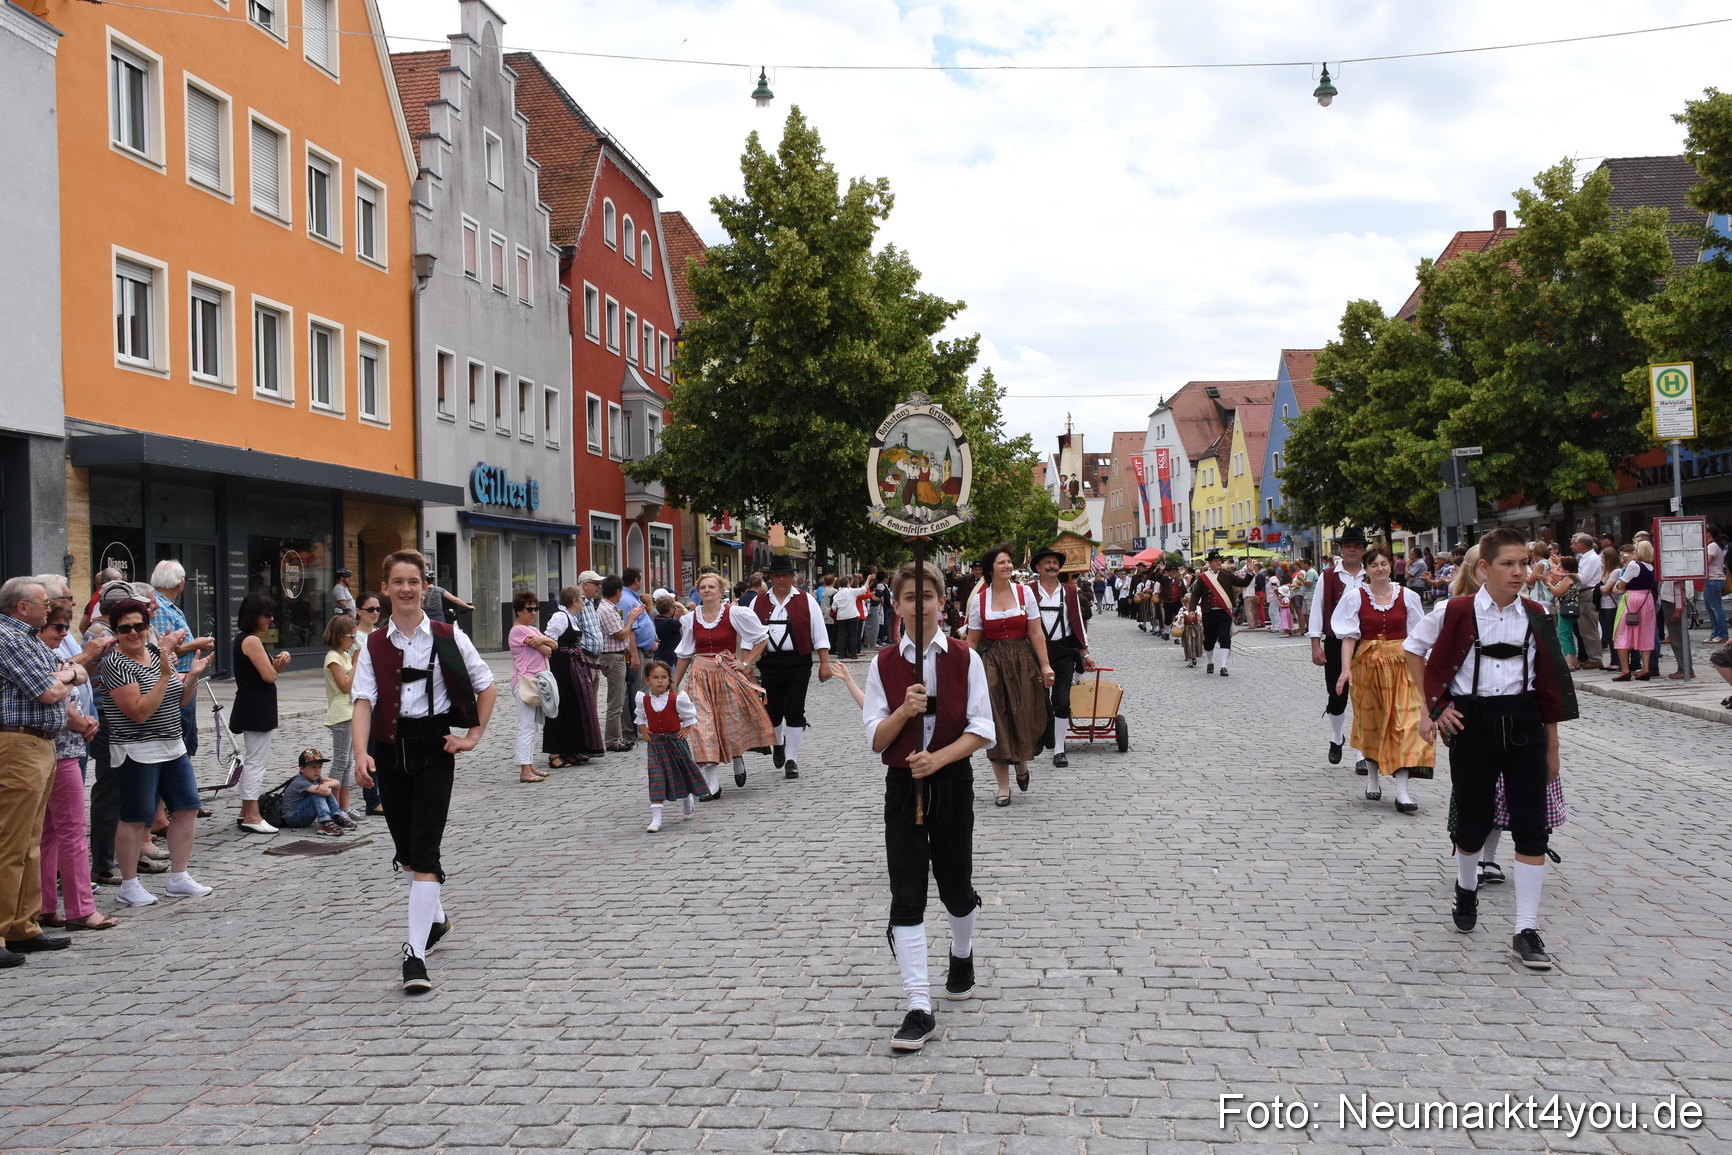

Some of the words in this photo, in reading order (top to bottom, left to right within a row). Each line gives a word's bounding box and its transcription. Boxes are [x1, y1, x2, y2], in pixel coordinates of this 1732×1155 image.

[1664, 375, 1680, 391] H
[928, 407, 954, 427] Gruppe
[471, 461, 527, 508] Eilles
[107, 557, 128, 569] Dianas
